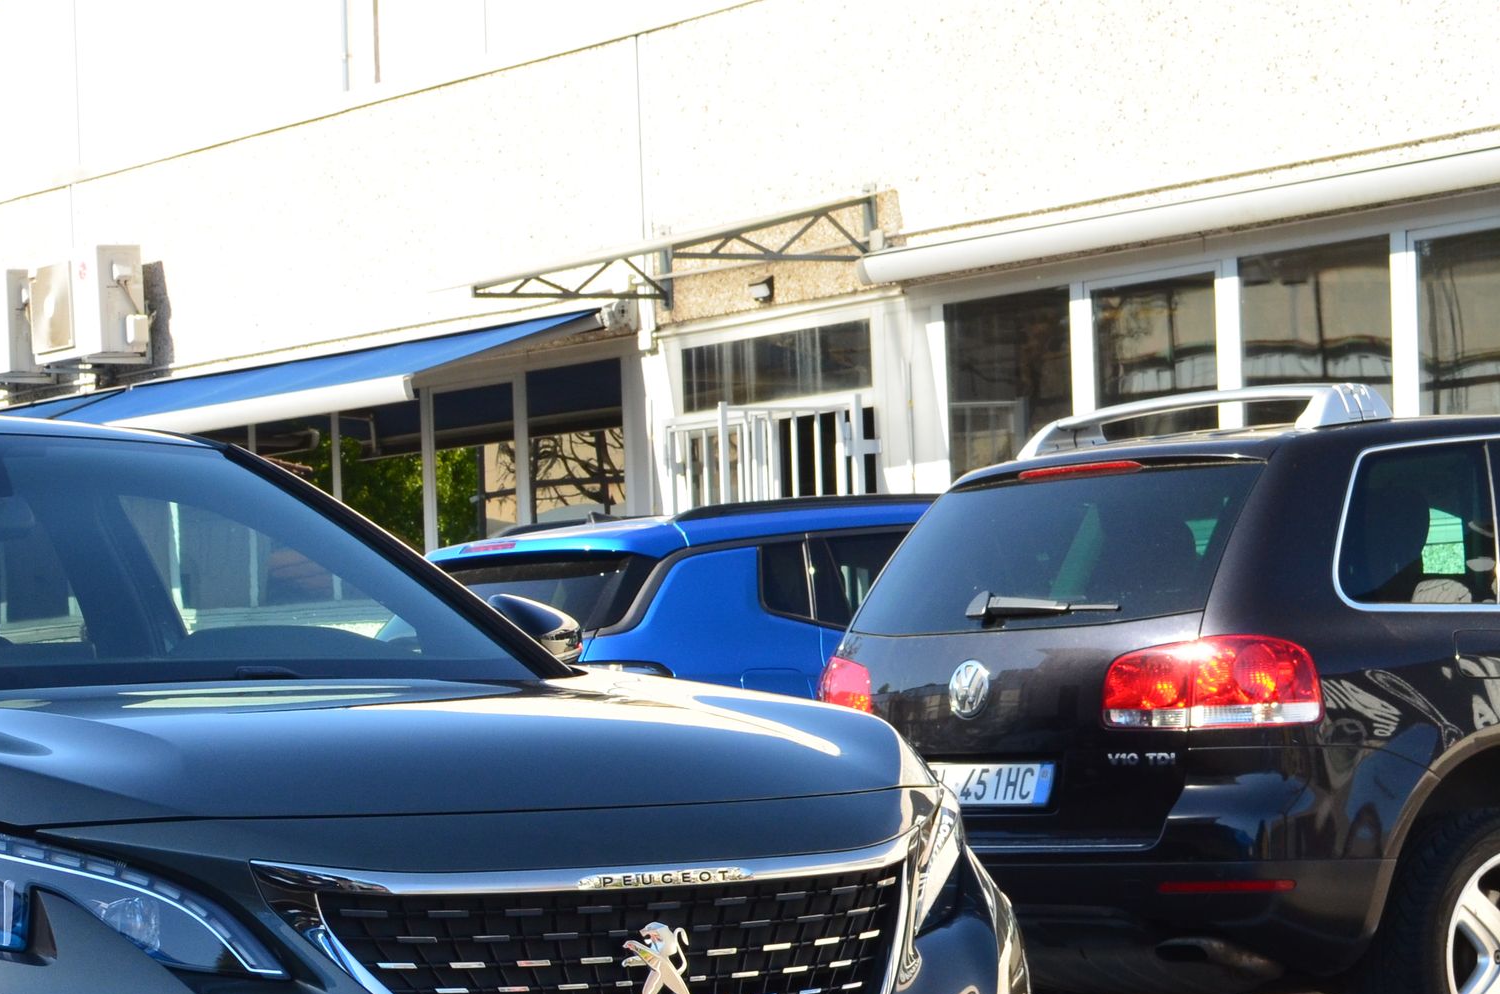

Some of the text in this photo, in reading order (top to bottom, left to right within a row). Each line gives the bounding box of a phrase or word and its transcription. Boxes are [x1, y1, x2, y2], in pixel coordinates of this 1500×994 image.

[1107, 752, 1176, 765] V10 TDI
[602, 870, 729, 888] PEUGEOT
